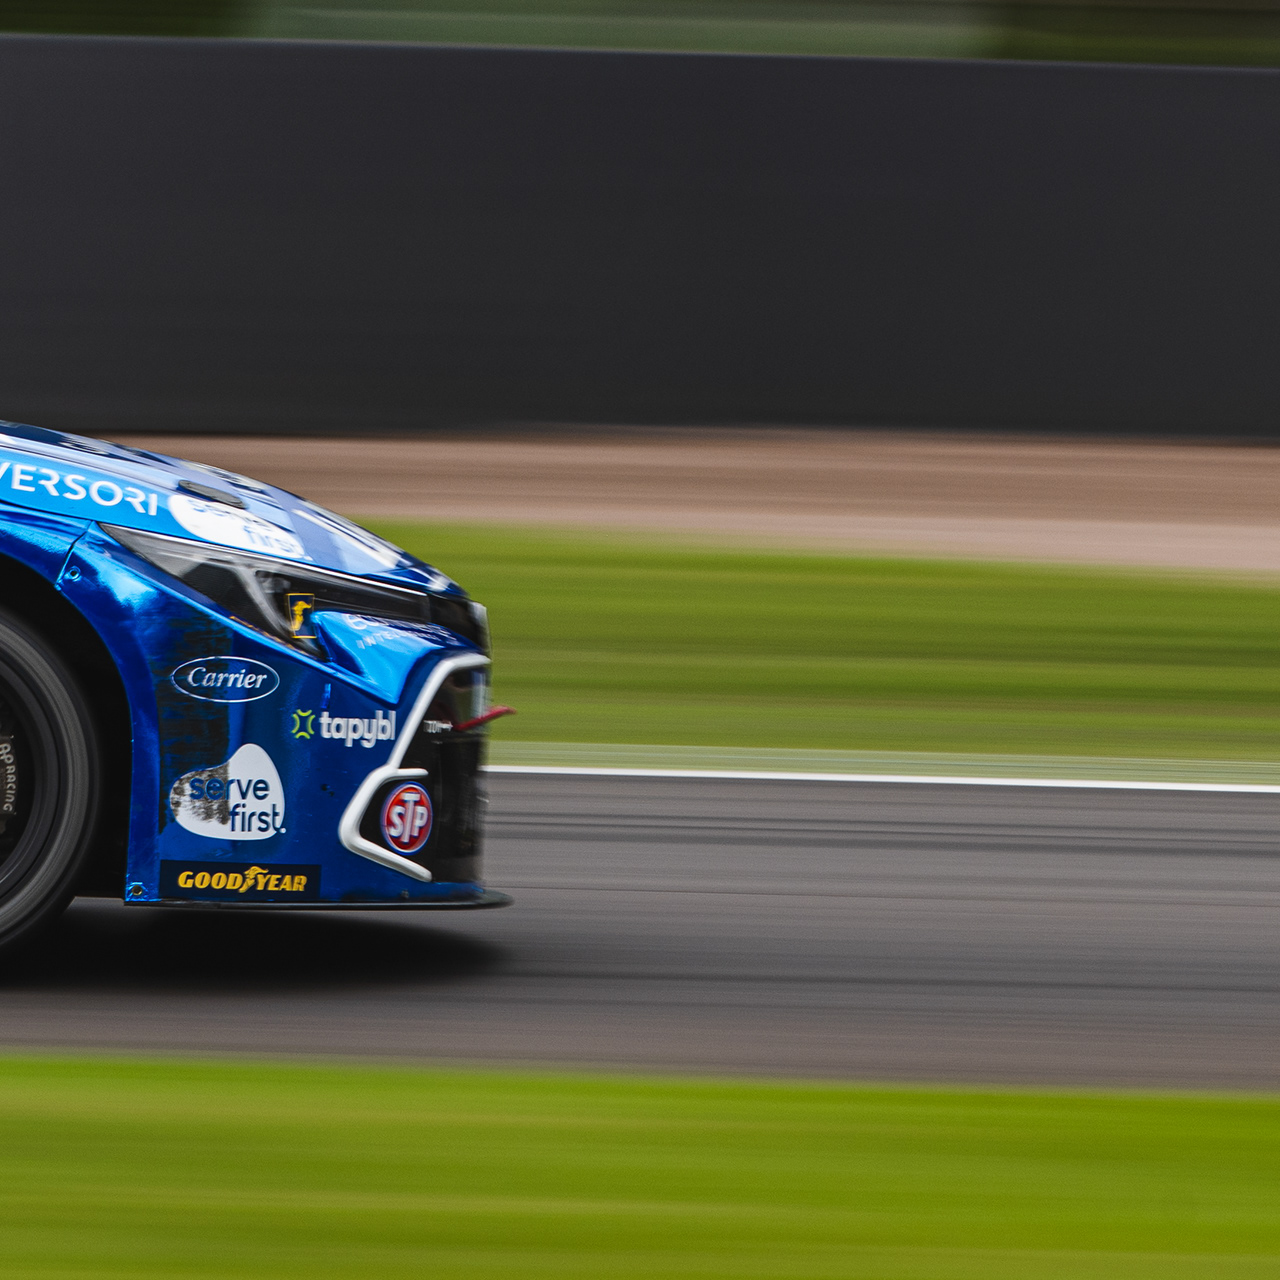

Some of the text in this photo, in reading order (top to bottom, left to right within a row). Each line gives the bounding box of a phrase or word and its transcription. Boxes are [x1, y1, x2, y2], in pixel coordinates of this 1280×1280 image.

[187, 666, 268, 690] Carrier
[320, 710, 396, 748] tapybl
[3, 765, 17, 812] RACING
[190, 778, 269, 801] serve
[389, 792, 429, 844] STP
[177, 866, 308, 893] GOODYEAR
